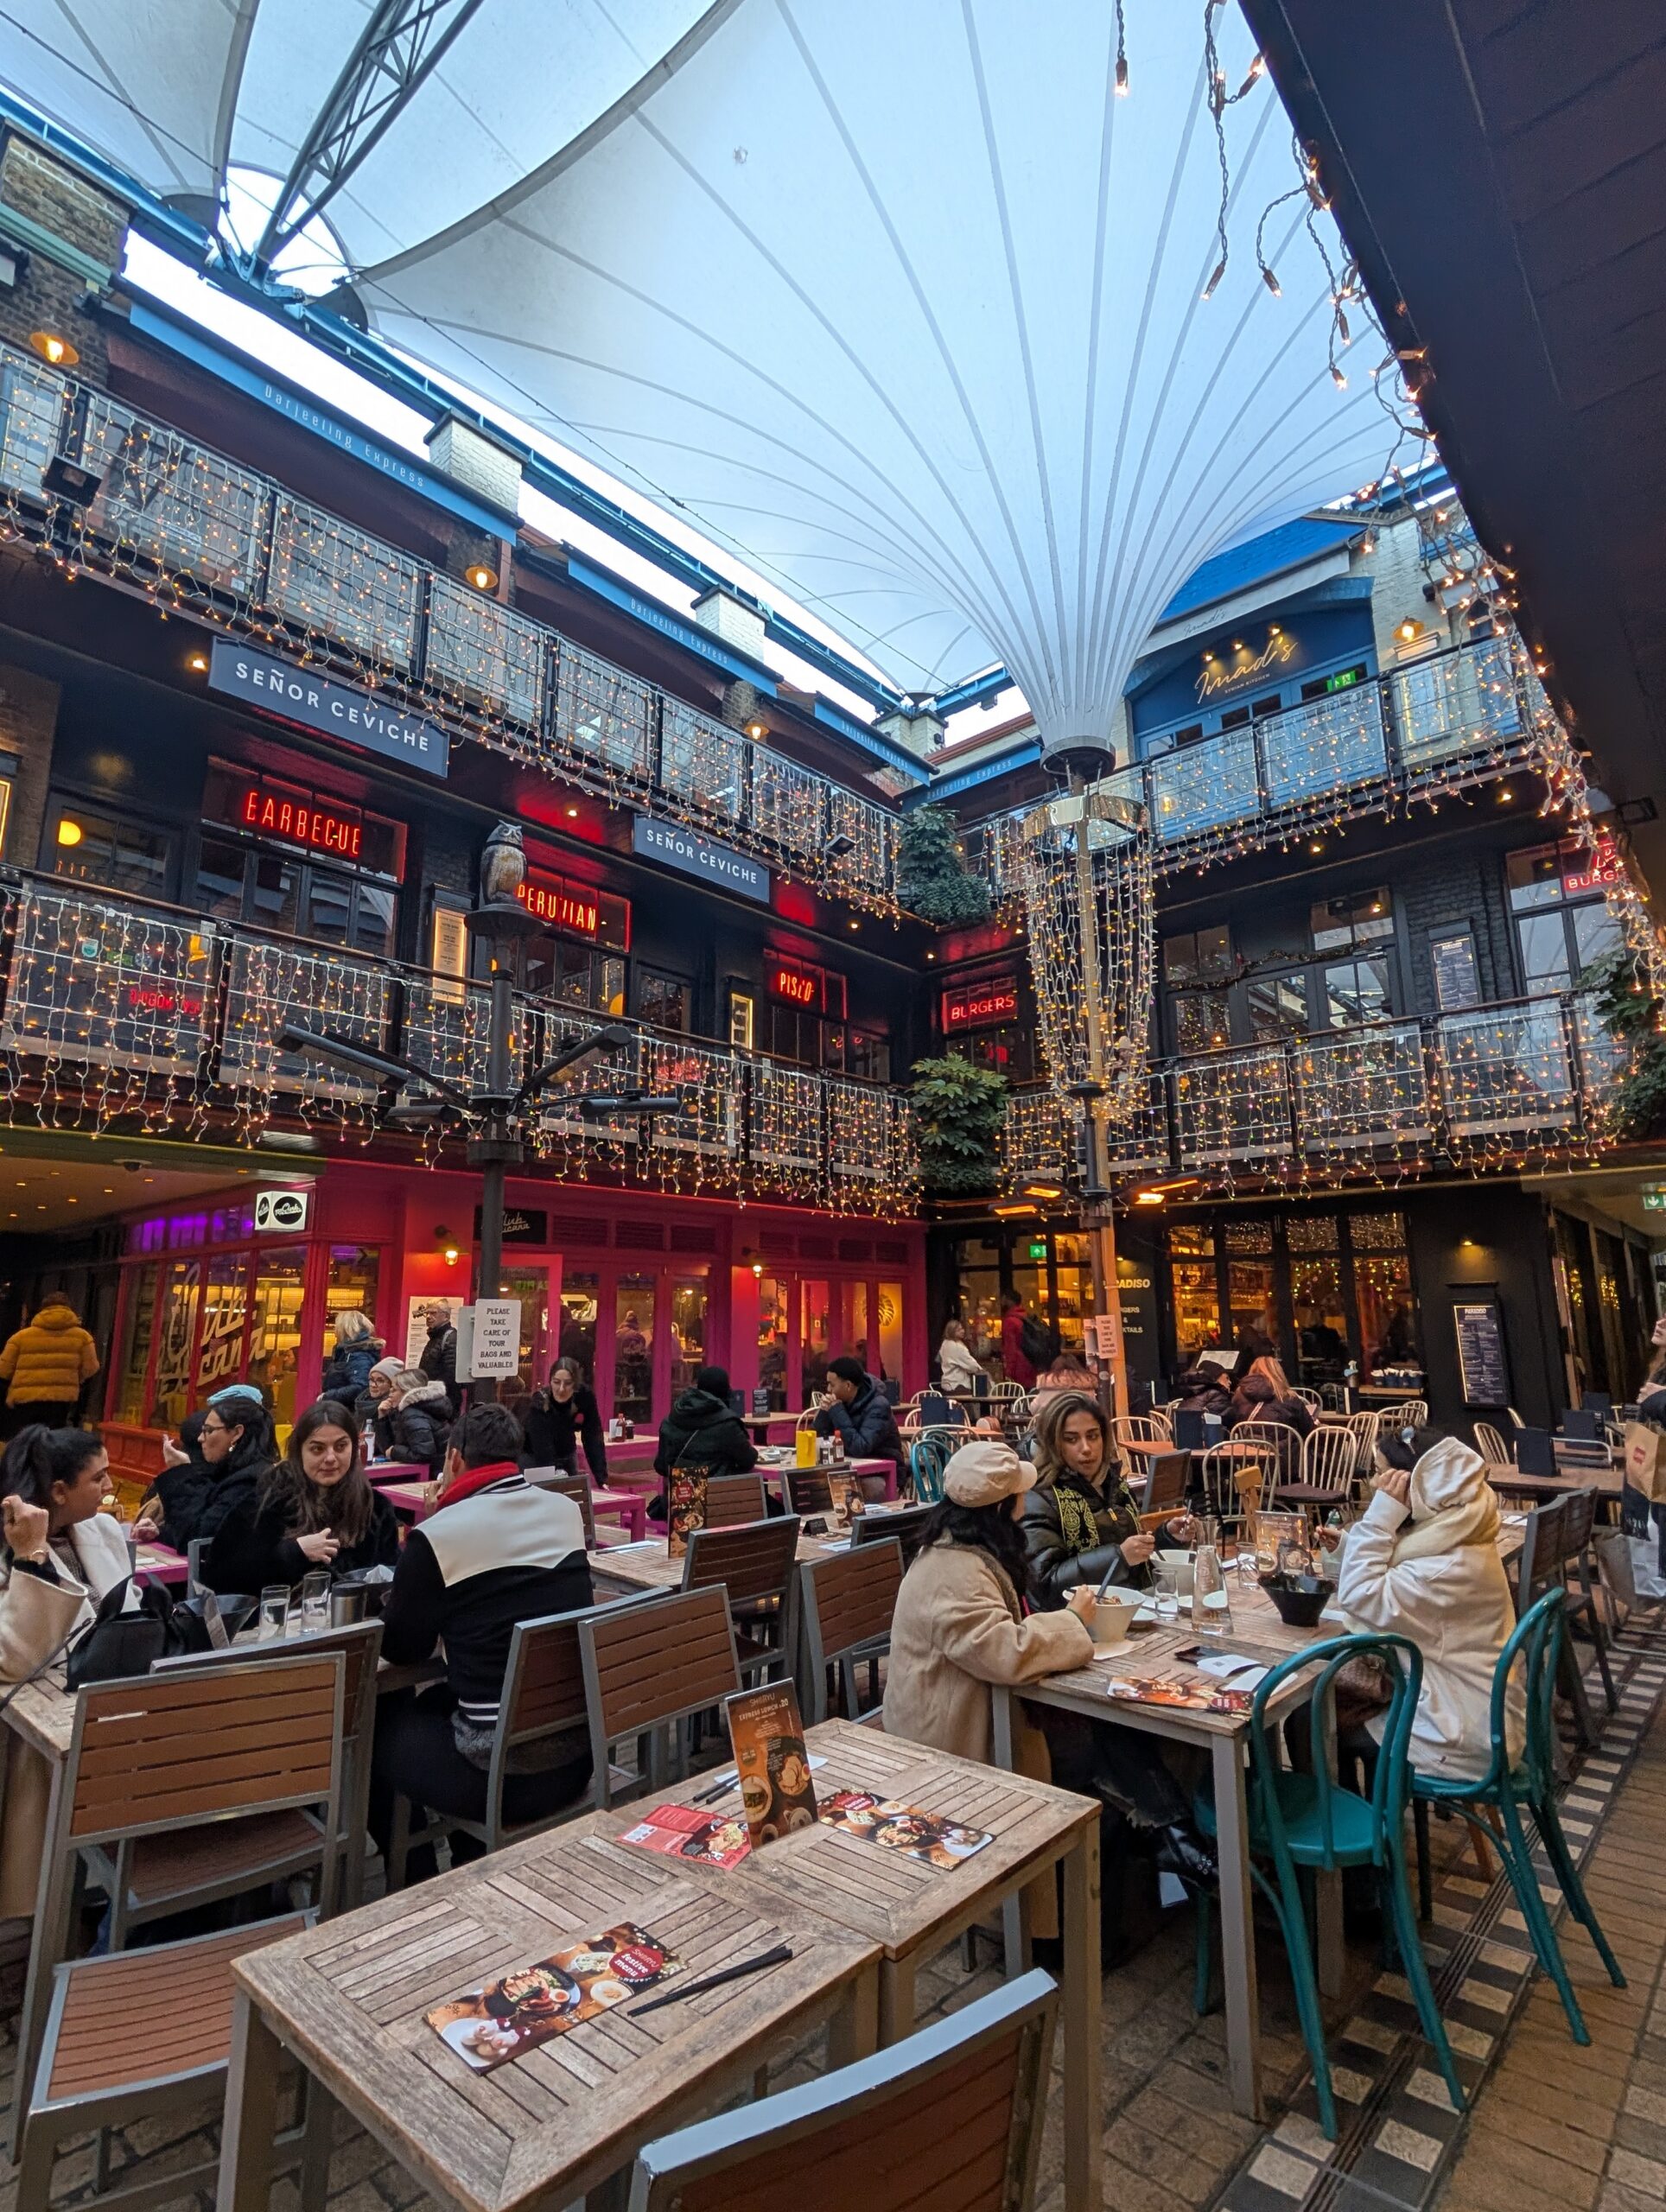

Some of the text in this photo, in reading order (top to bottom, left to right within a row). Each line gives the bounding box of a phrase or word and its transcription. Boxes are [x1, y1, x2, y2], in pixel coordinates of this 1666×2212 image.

[264, 385, 423, 487] Darjeeling Express
[235, 662, 429, 752] SEÑOR CEVICHE
[646, 829, 757, 884] SEÑOR CEVICHE
[1568, 869, 1618, 889] BURG
[951, 995, 1015, 1020] BURGERS
[501, 1211, 526, 1226] lub
[1115, 1279, 1151, 1288] ADISO
[614, 1959, 639, 1977] menu
[621, 1953, 649, 1974] festive
